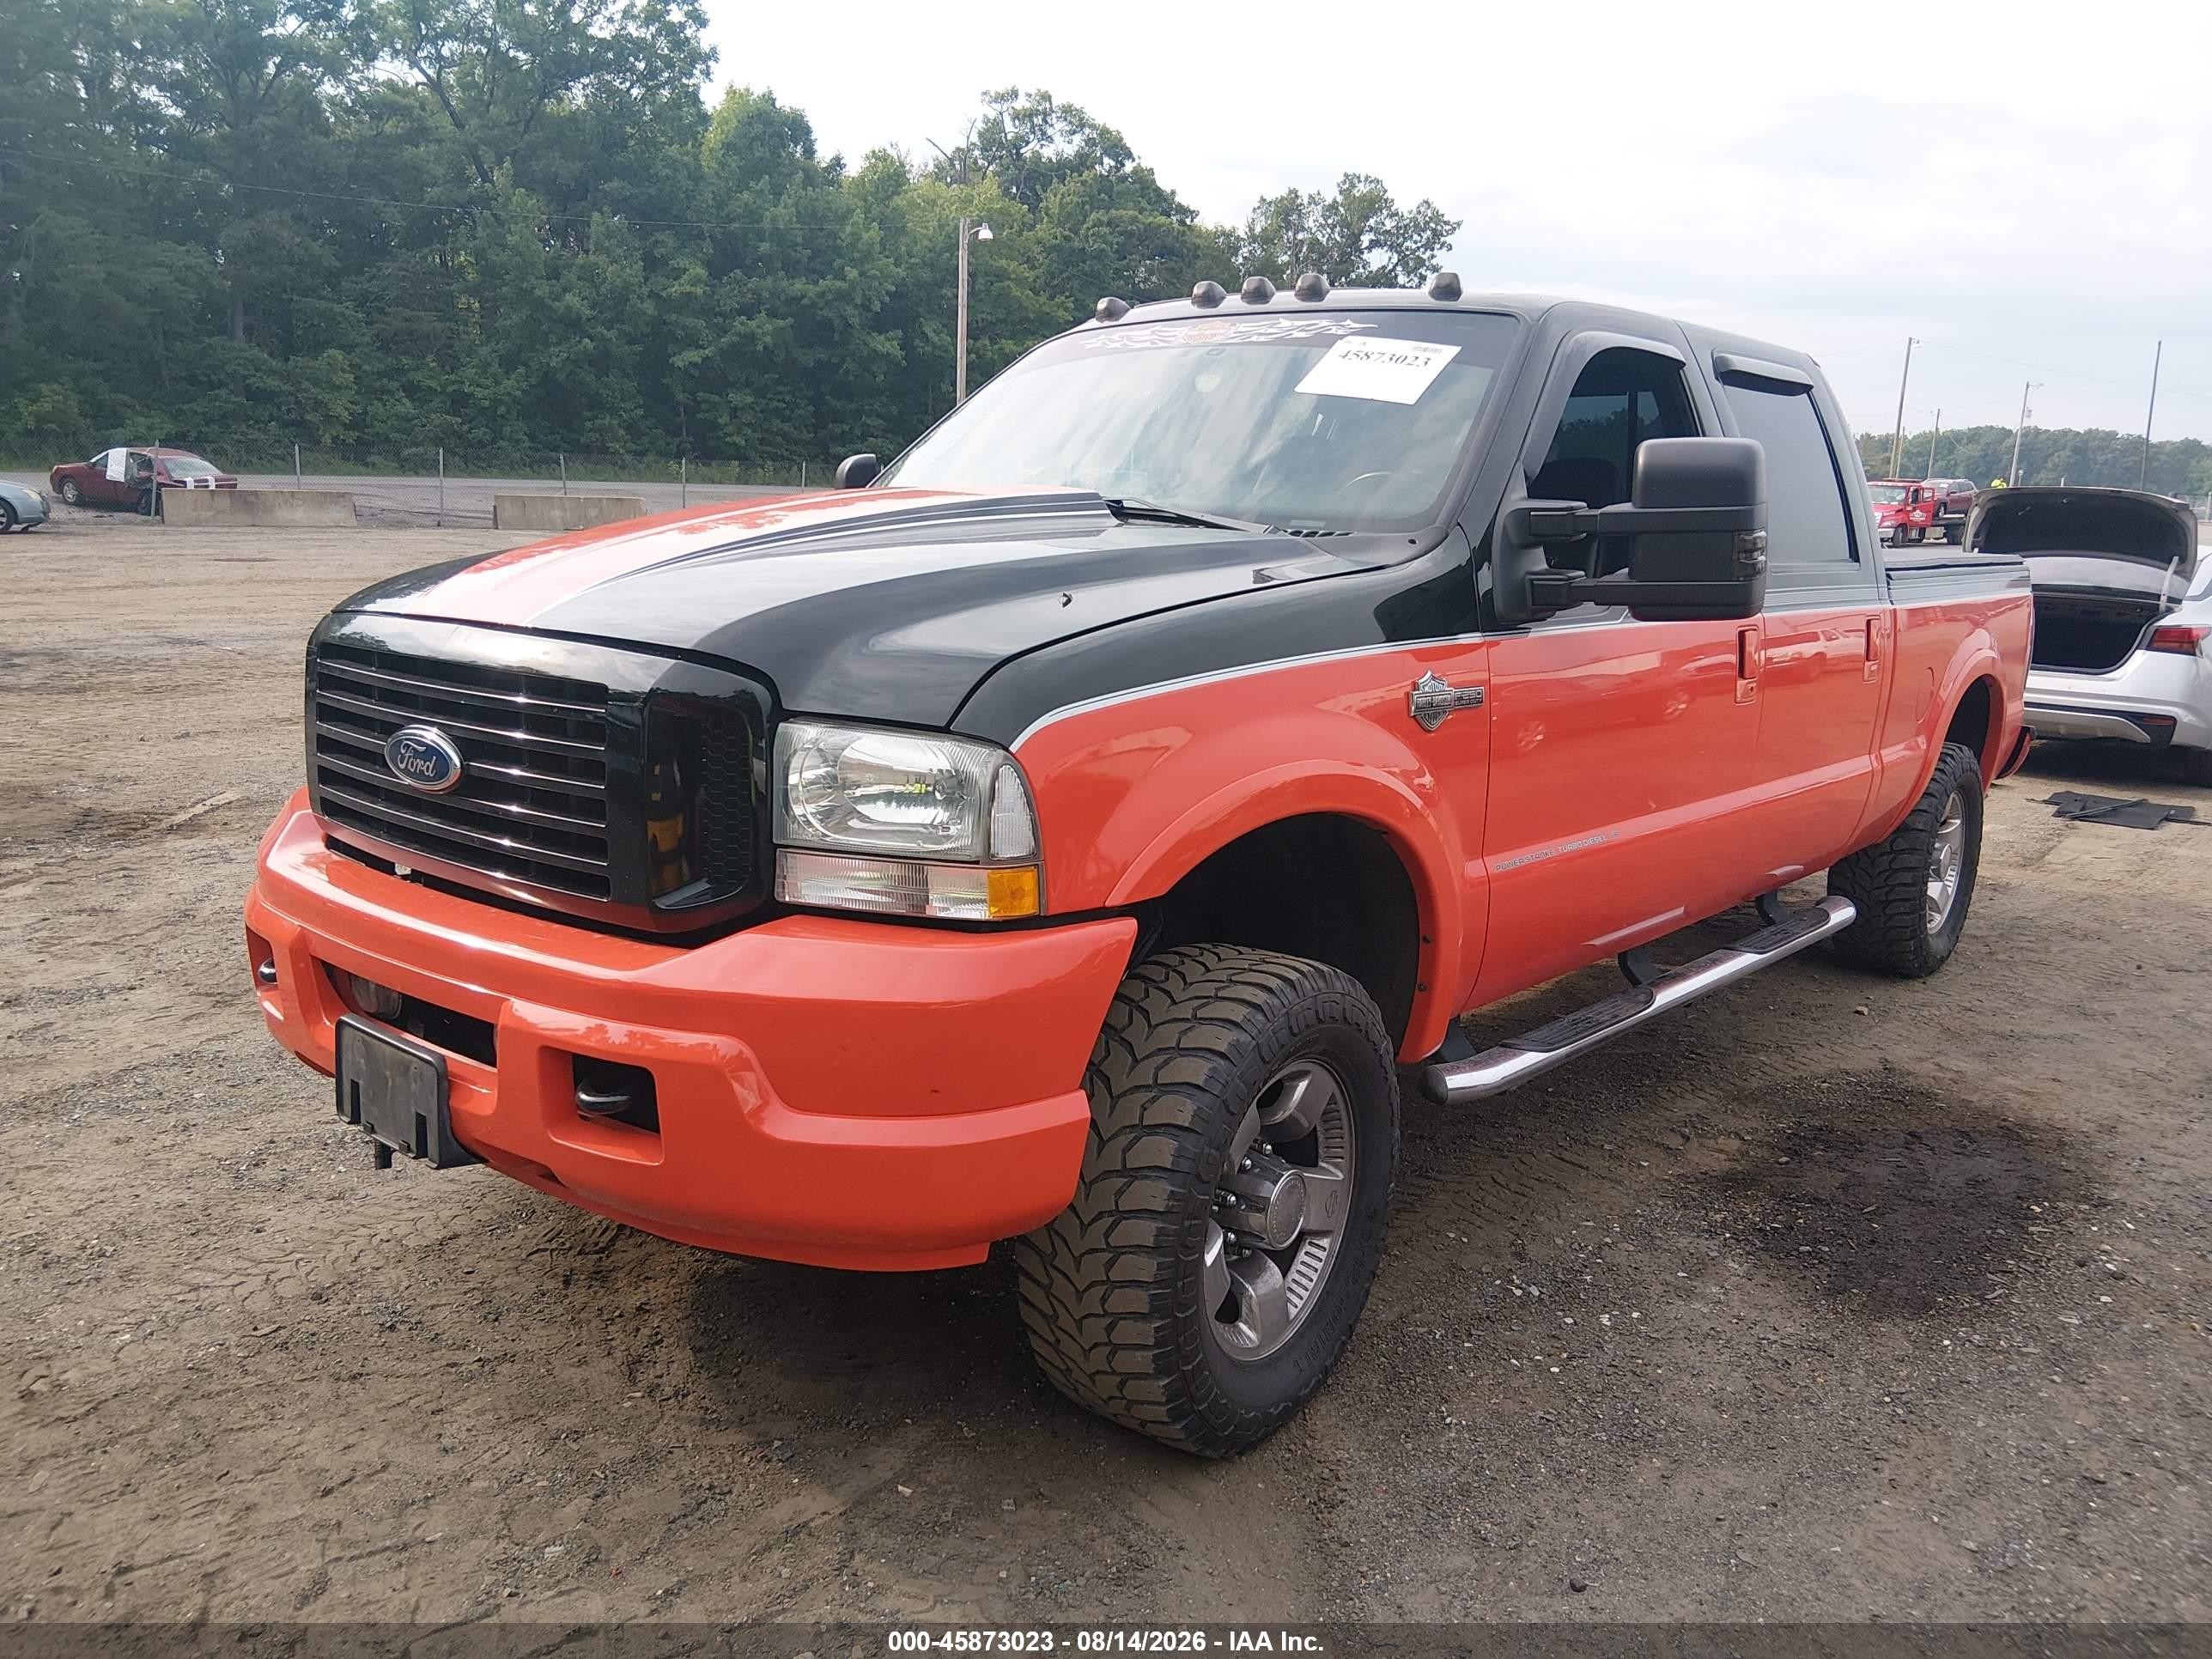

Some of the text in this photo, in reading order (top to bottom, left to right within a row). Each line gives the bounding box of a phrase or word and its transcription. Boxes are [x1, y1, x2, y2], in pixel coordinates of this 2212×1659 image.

[1339, 349, 1431, 368] 45873023
[1422, 679, 1444, 693] MOTOR
[398, 740, 436, 777] Ford
